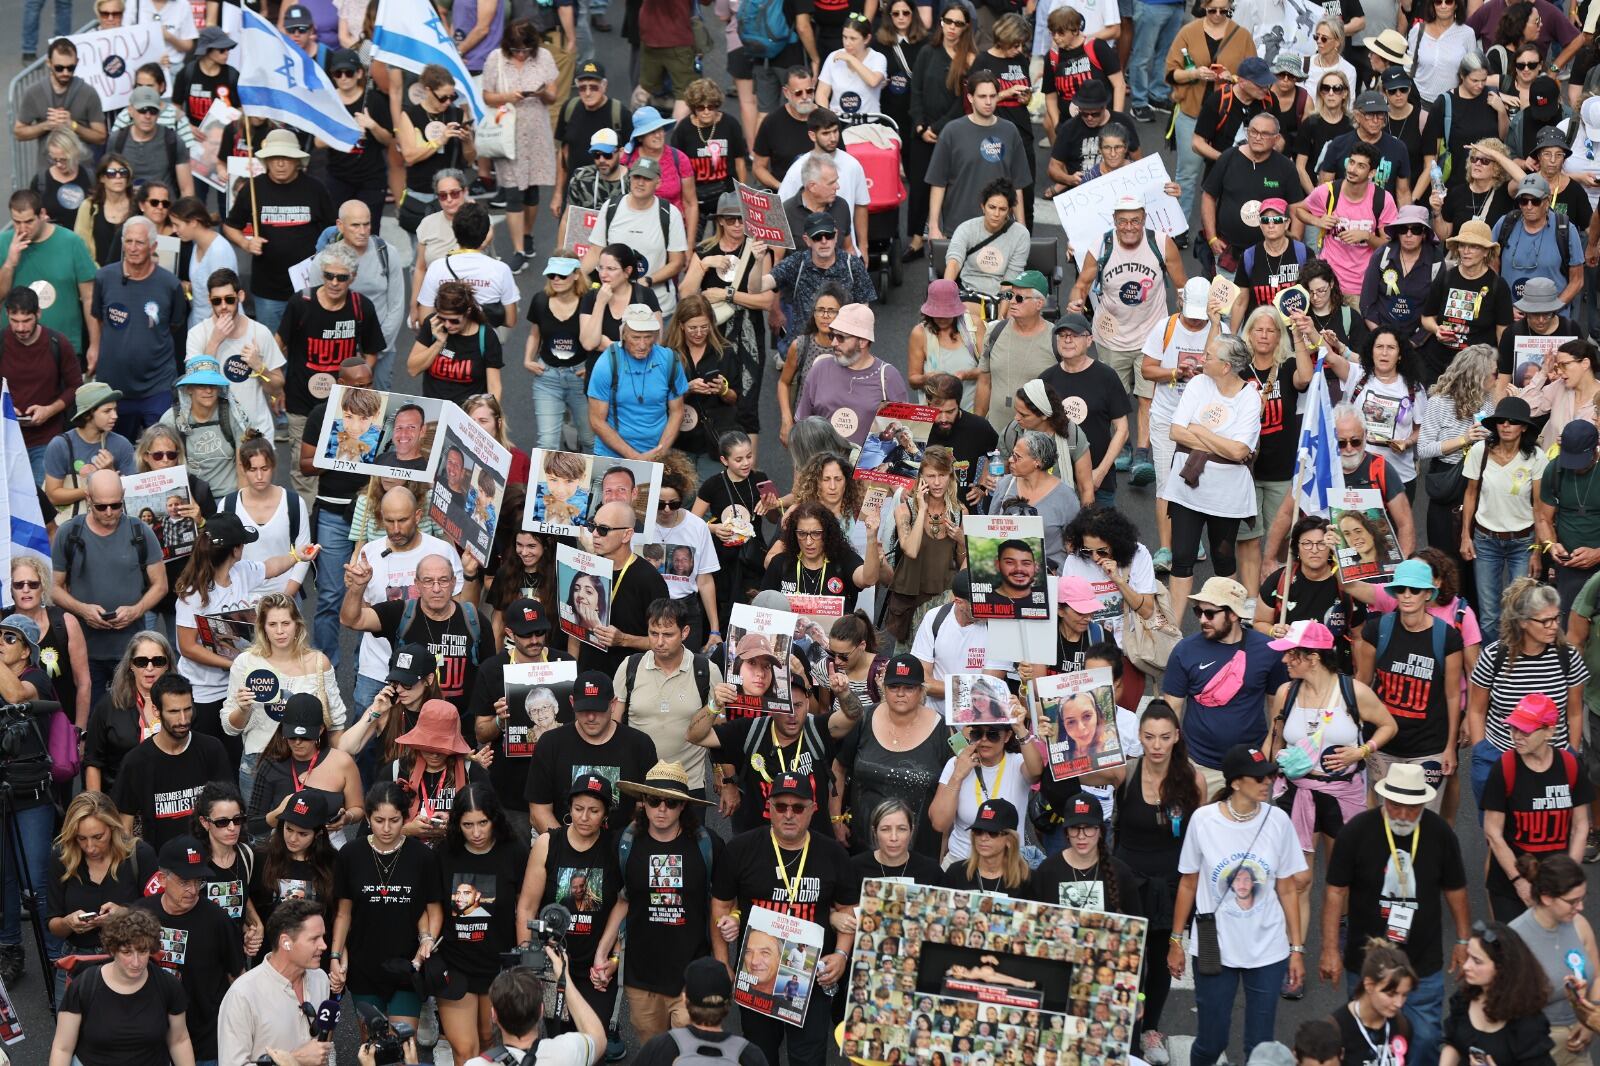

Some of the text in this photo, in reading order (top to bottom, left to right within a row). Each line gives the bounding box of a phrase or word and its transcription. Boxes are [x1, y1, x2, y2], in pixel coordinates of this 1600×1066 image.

[1062, 163, 1162, 216] HOSTAGE
[1283, 294, 1301, 307] HOME
[1287, 299, 1302, 311] NOW
[109, 307, 128, 318] HOME
[109, 313, 126, 324] NOW
[228, 359, 248, 371] HOME
[228, 365, 246, 376] NOW
[390, 468, 412, 478] אוהד
[435, 481, 452, 504] BRING
[433, 493, 449, 514] THEM
[539, 522, 569, 536] Eitan
[971, 583, 992, 593] BRING
[973, 592, 986, 603] HIM
[973, 603, 1014, 614] HOME NOW!
[442, 634, 467, 646] מחזירים
[1408, 653, 1434, 669] מחזירים
[1391, 661, 1433, 681] אותם הביתה
[250, 677, 274, 685] HOME
[585, 687, 598, 695] NOW
[509, 726, 528, 735] BRING
[509, 735, 521, 743] HER
[509, 744, 527, 752] HOME
[1050, 741, 1069, 753] BRING
[1052, 753, 1064, 764] HER
[1054, 756, 1090, 775] HOME NOW!
[154, 790, 182, 802] HOSTAGES
[182, 788, 193, 798] AND
[1546, 784, 1571, 797] מחזירים
[155, 799, 190, 815] FAMILIES
[1533, 796, 1573, 810] אותם הביתה
[1513, 810, 1570, 842] עכשיו
[1211, 852, 1257, 883] BRING OMER
[799, 890, 820, 903] אותם
[578, 915, 592, 923] ROMI
[739, 971, 759, 985] BRING
[737, 981, 749, 993] HIM
[735, 990, 773, 1009] HOME NOW!
[320, 1009, 330, 1021] 2
